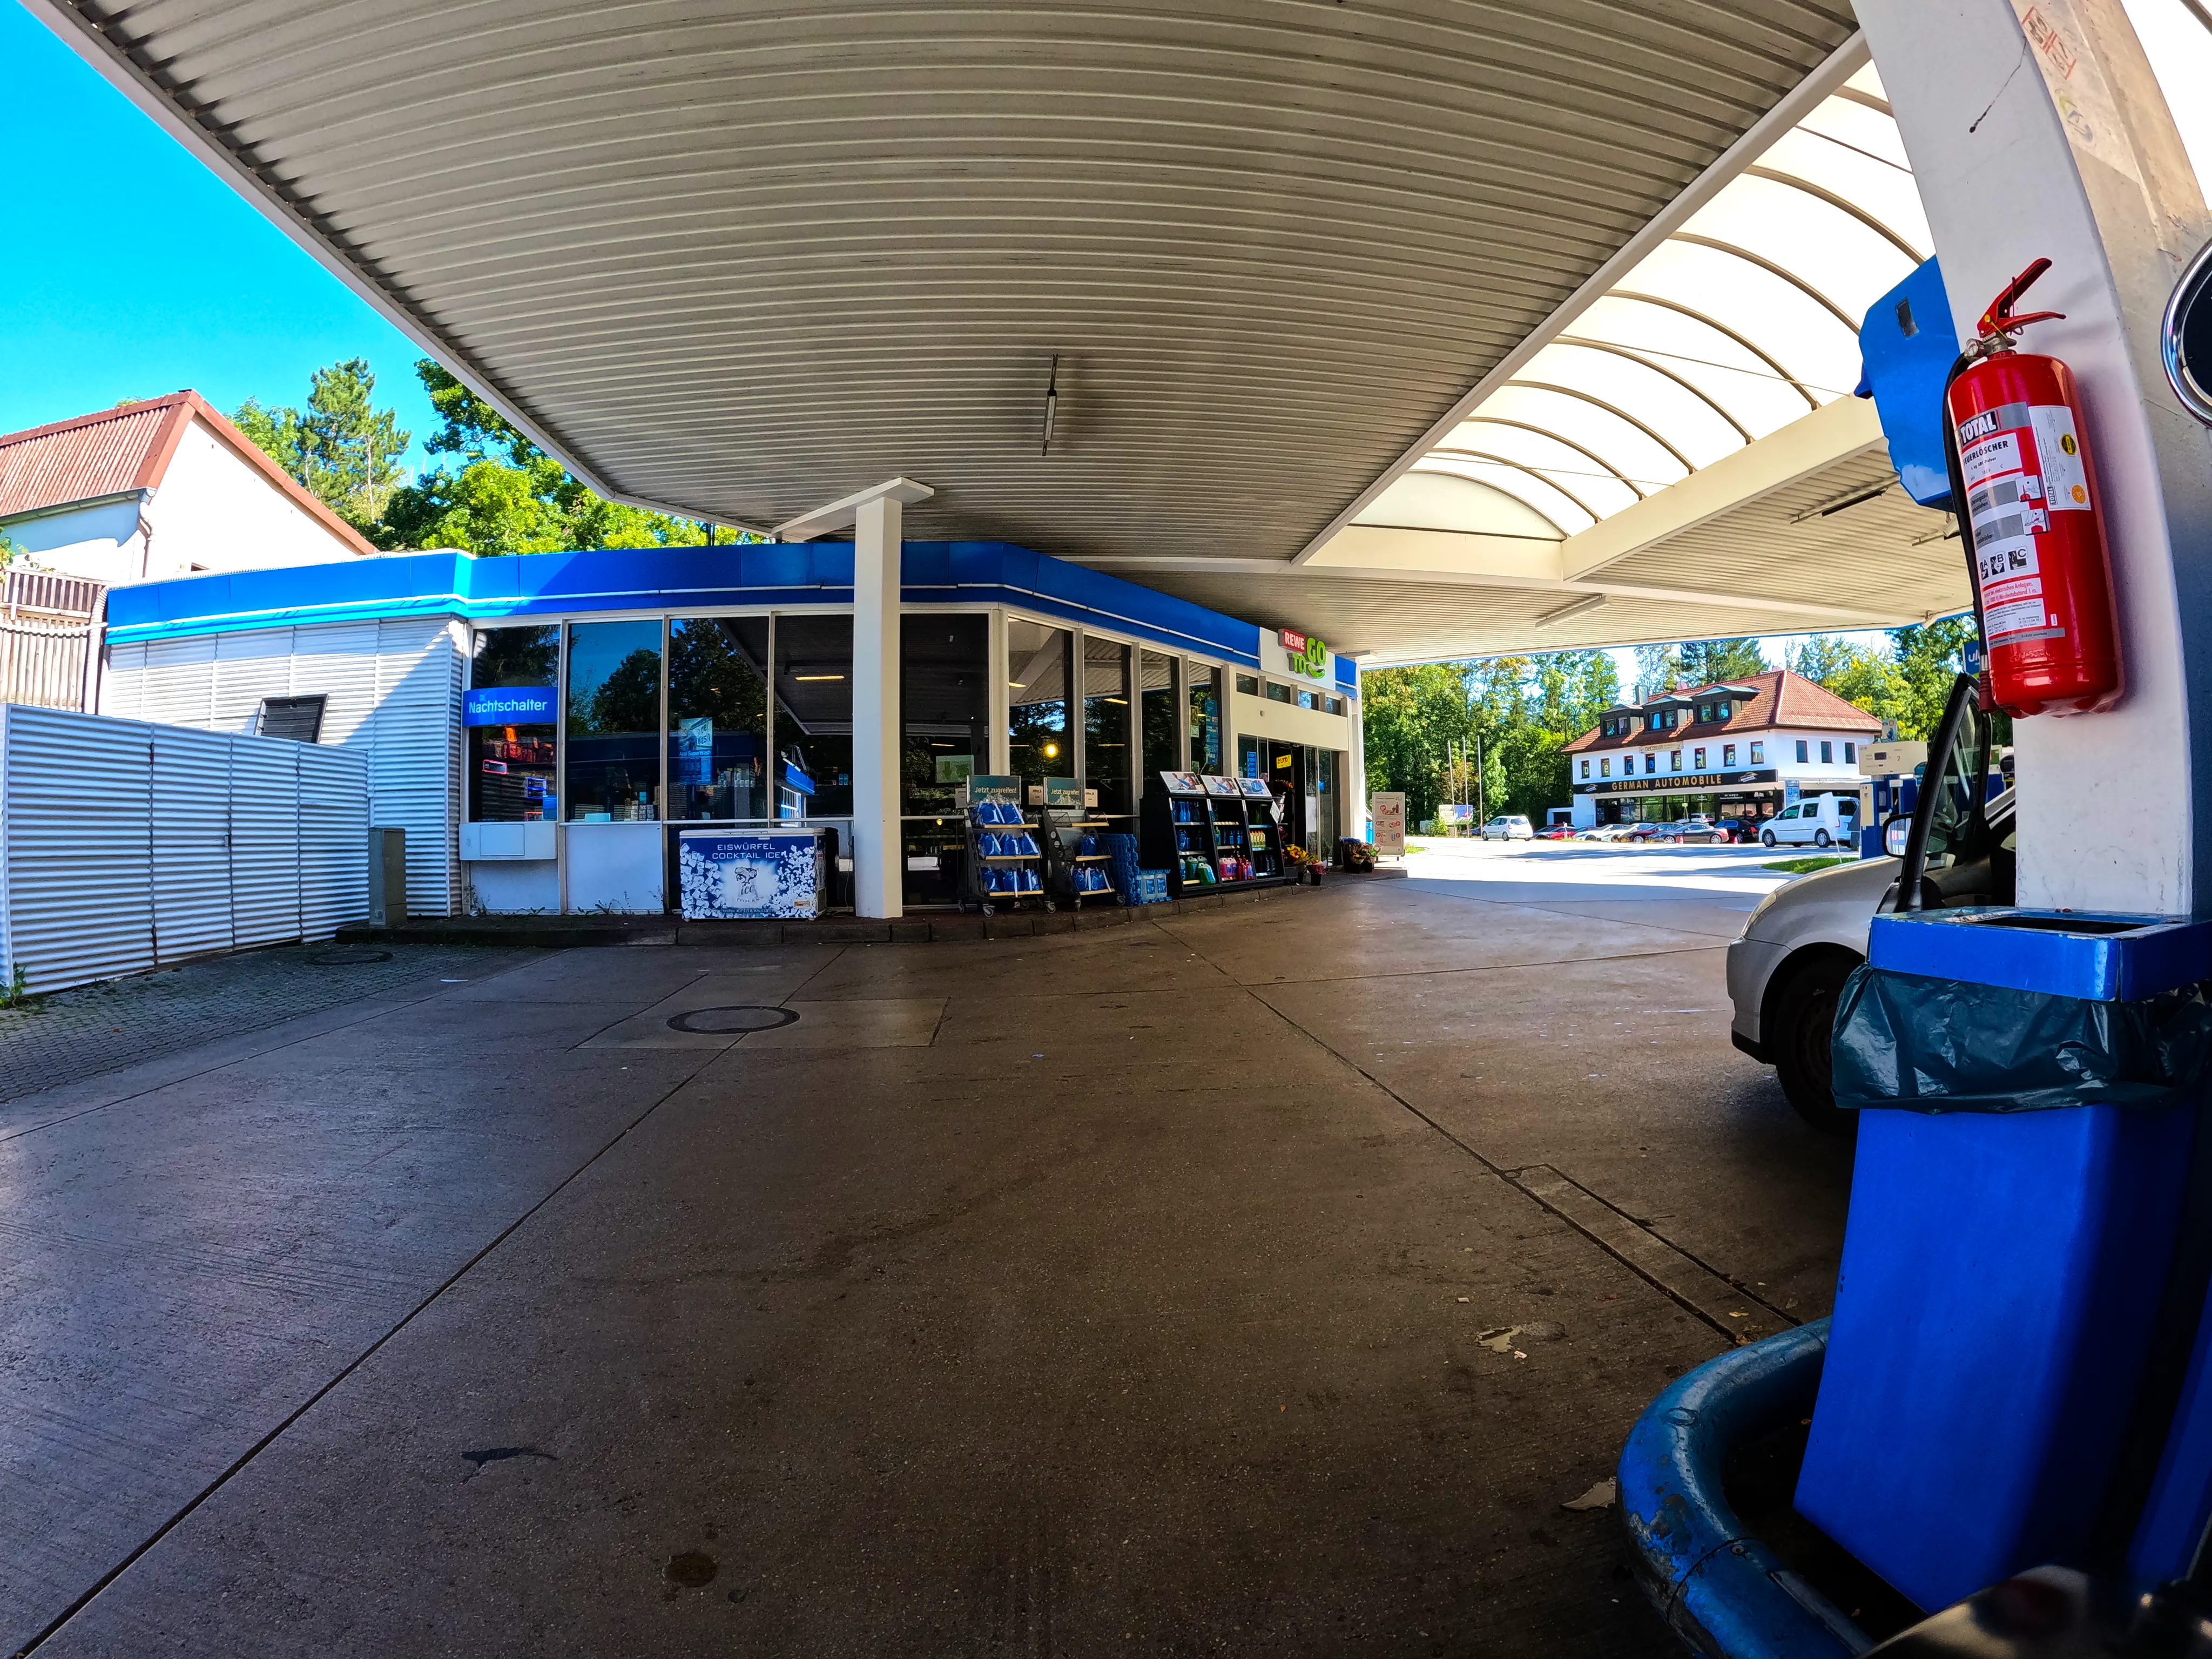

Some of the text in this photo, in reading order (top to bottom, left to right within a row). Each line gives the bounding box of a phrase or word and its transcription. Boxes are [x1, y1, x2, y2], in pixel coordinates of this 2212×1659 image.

[1960, 413, 1997, 443] TOTAL
[1963, 440, 2009, 466] FEUERLÖSCHER
[2047, 487, 2056, 505] TOTAL
[1983, 549, 2027, 568] A B C
[1285, 631, 1305, 650] REWE
[1292, 637, 1326, 674] TO GO
[469, 699, 548, 714] Nachtschalter
[1611, 774, 1722, 791] GERMAN AUTOMOBILE
[717, 842, 775, 851] EISWÜRFEL
